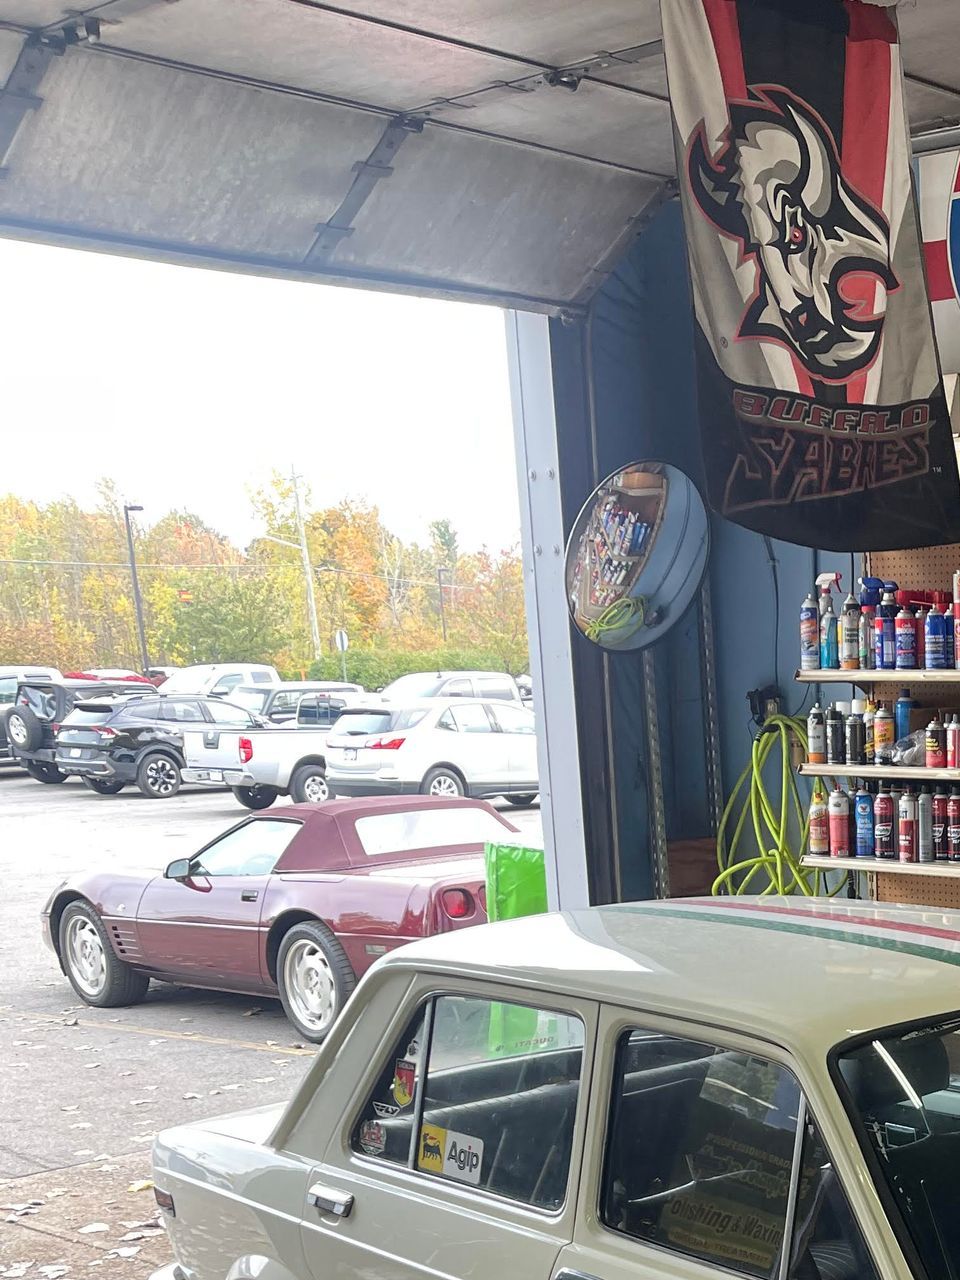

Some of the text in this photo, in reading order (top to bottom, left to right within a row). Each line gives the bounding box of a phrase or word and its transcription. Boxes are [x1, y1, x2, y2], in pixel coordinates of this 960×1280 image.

[732, 388, 930, 434] BUFFALO
[375, 1102, 399, 1115] FLY
[447, 1140, 480, 1173] Agip
